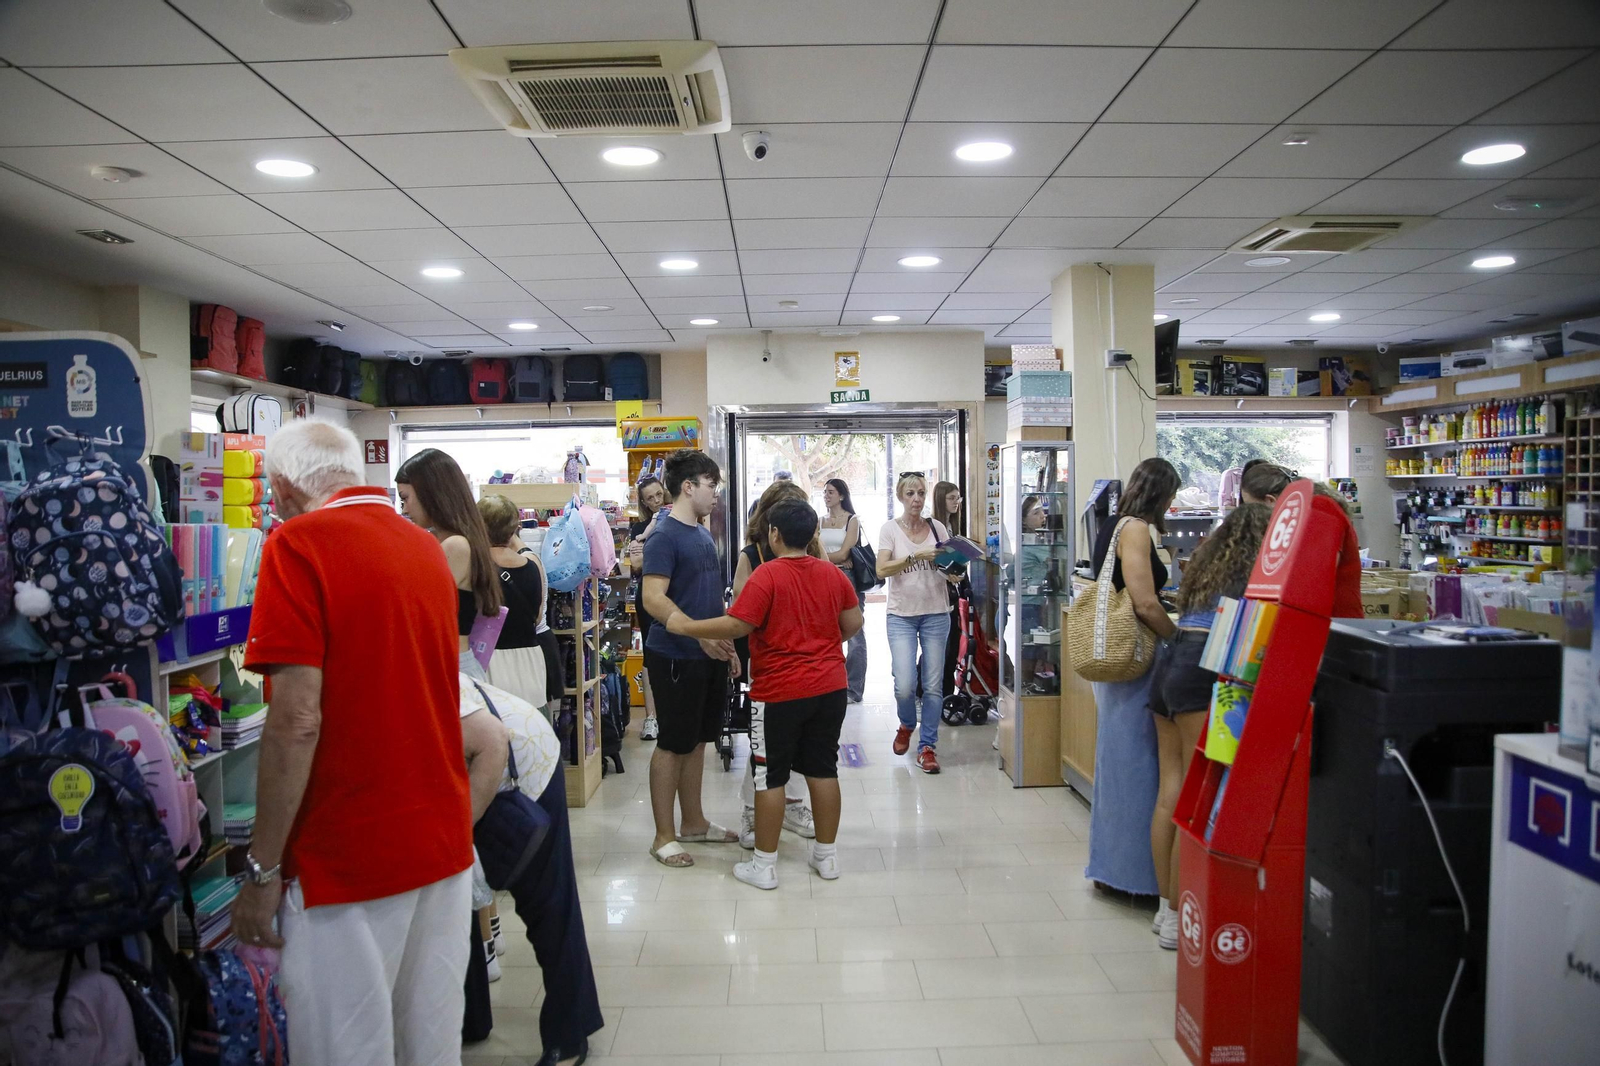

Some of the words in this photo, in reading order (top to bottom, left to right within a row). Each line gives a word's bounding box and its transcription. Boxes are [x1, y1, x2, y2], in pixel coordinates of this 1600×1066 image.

[834, 391, 867, 402] SALIDA
[1270, 508, 1297, 550] 6€
[1182, 902, 1200, 949] 6€
[1217, 931, 1245, 952] 6€
[1210, 1056, 1246, 1064] EDITORES
